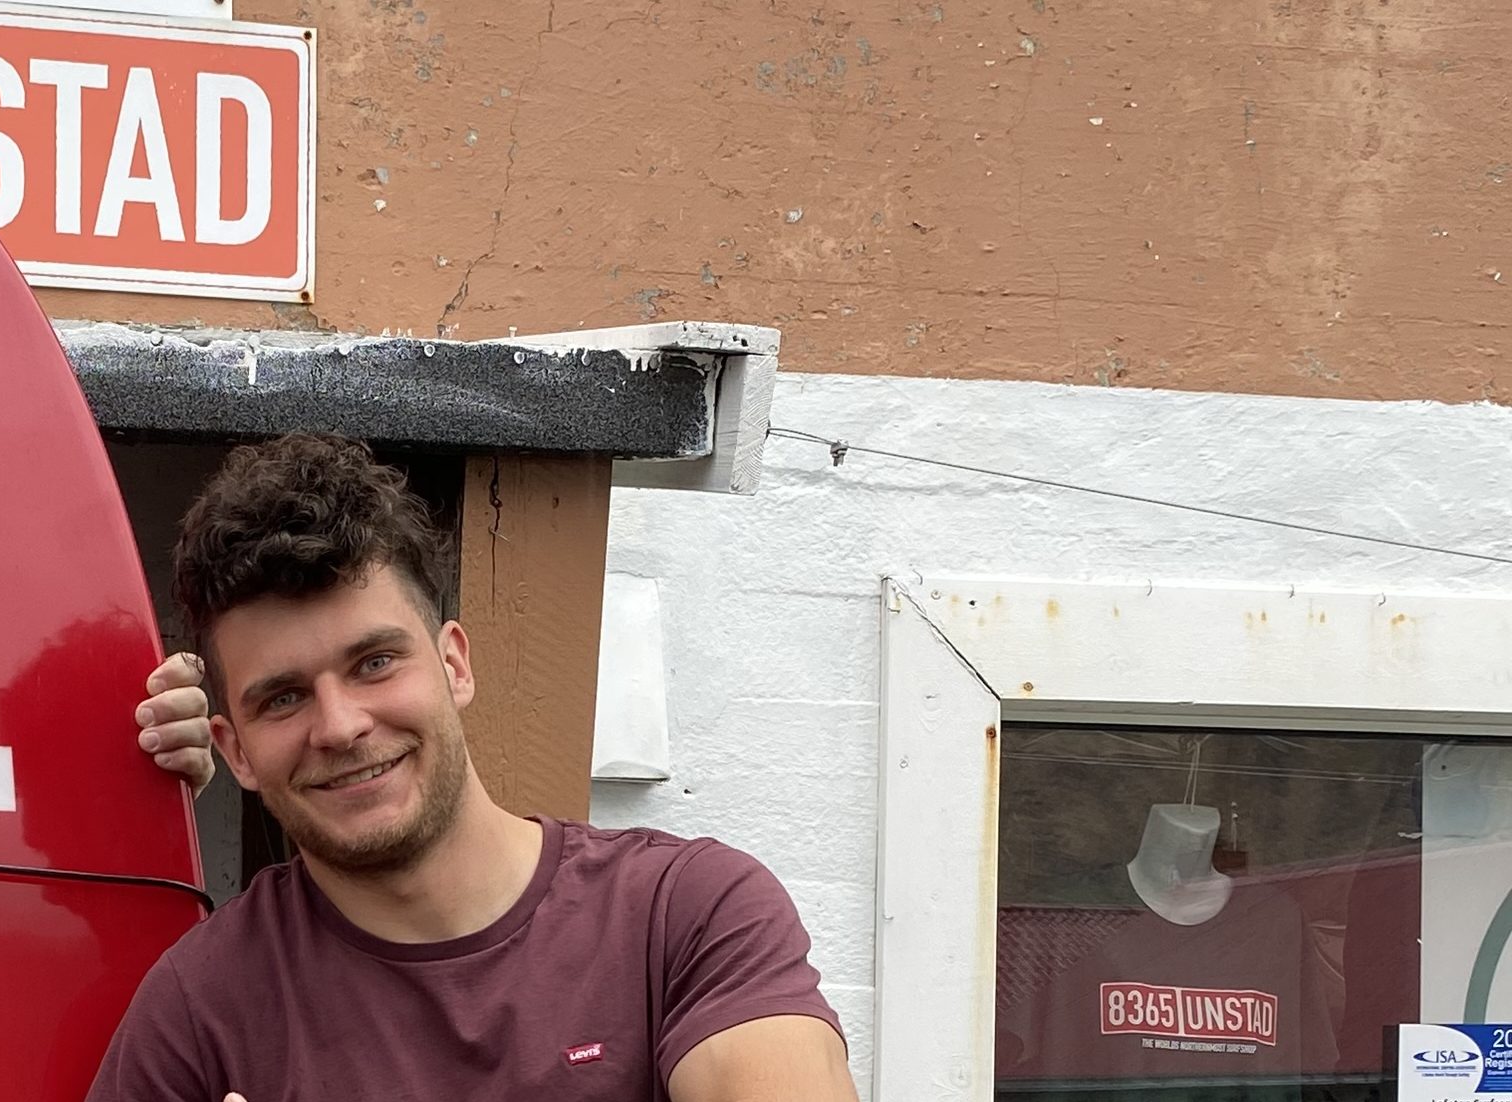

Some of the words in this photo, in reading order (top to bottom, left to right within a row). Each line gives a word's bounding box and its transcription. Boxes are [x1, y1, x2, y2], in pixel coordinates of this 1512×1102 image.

[1108, 990, 1175, 1028] 8365
[1187, 995, 1273, 1036] UNSTAD
[1435, 1050, 1457, 1063] ISA
